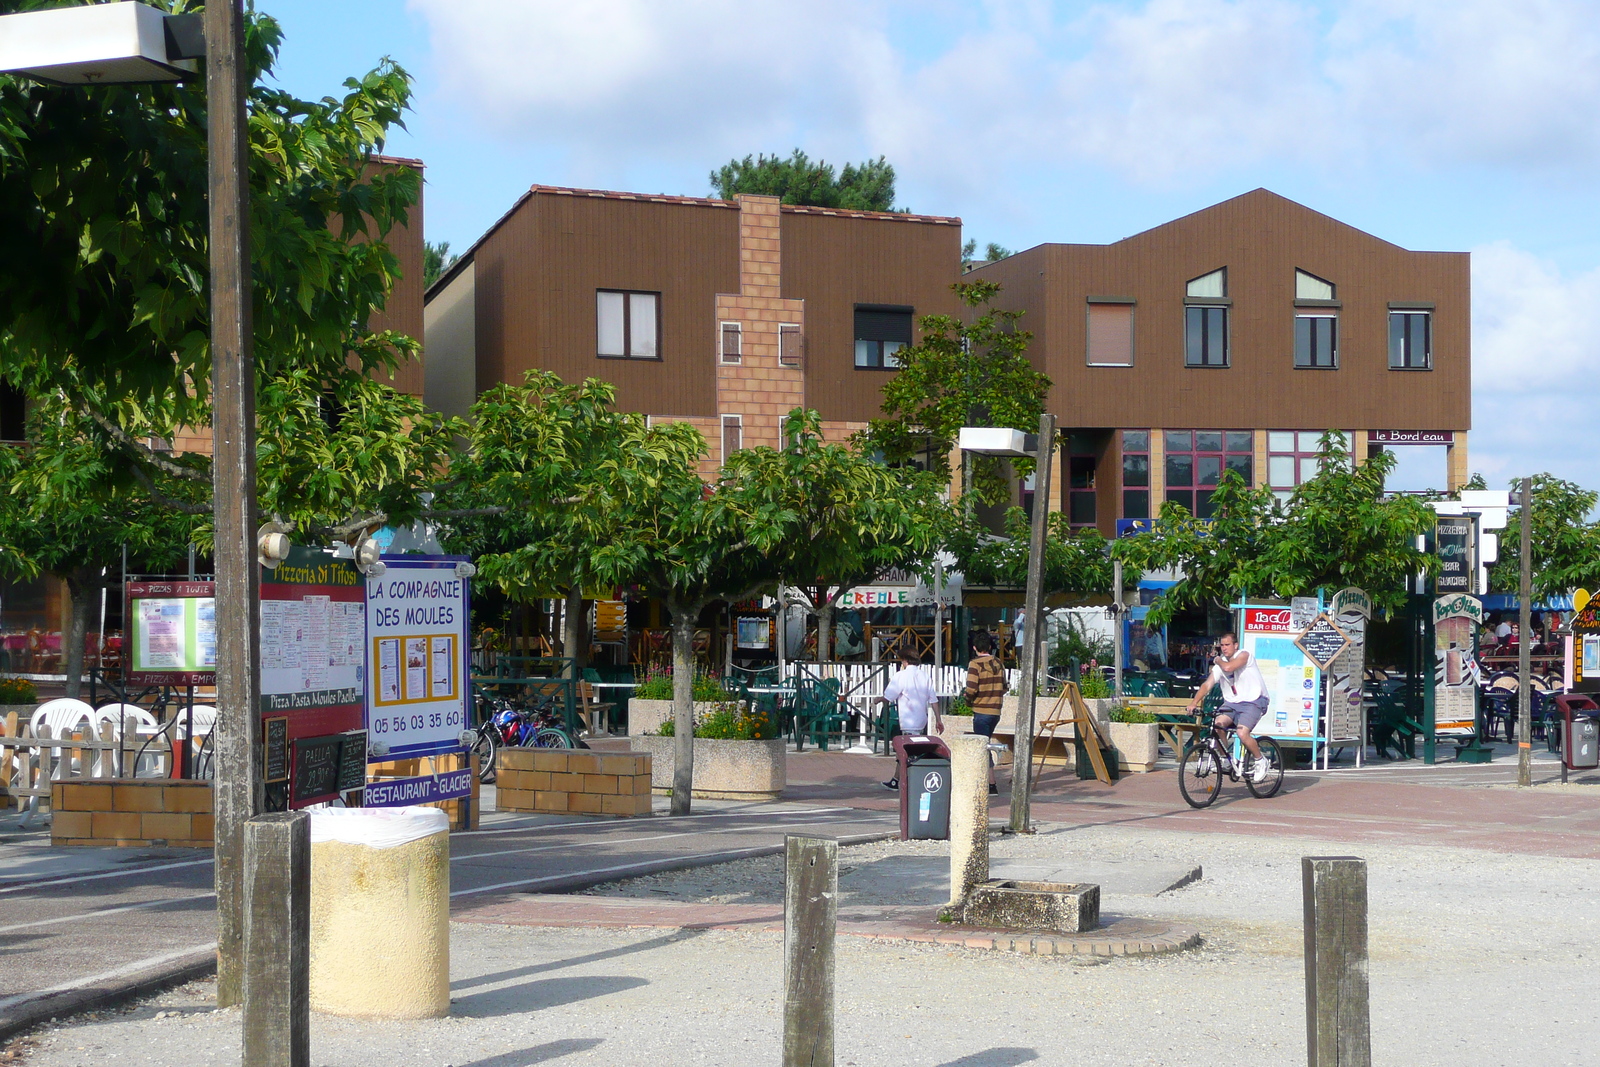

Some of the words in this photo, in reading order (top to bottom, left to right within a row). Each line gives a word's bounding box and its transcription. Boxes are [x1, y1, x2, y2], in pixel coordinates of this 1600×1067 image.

[1376, 430, 1386, 440] le
[1390, 430, 1444, 441] Bord'eau
[274, 561, 316, 583] Pizzeria
[318, 564, 329, 584] di
[148, 585, 172, 594] PIZZAS
[177, 585, 183, 594] A
[369, 581, 384, 600] LA
[389, 580, 460, 599] COMPAGNIE
[1504, 596, 1519, 609] LE
[376, 606, 400, 627] DES
[405, 606, 454, 626] MOULES
[1247, 622, 1264, 630] BAR
[1270, 623, 1290, 631] BRAS
[144, 674, 176, 684] PIZZAS
[191, 674, 216, 685] EMPO
[271, 694, 290, 709] Pizza
[291, 693, 311, 708] Pasta
[312, 688, 337, 706] Moules
[338, 689, 357, 704] Paella
[374, 719, 389, 734] 05
[393, 716, 407, 732] 56
[410, 715, 425, 730] 03
[429, 713, 442, 728] 35
[446, 711, 460, 726] 60
[305, 746, 331, 764] PAELLA
[365, 781, 431, 805] RESTAURANT
[439, 774, 472, 794] GLACIER
